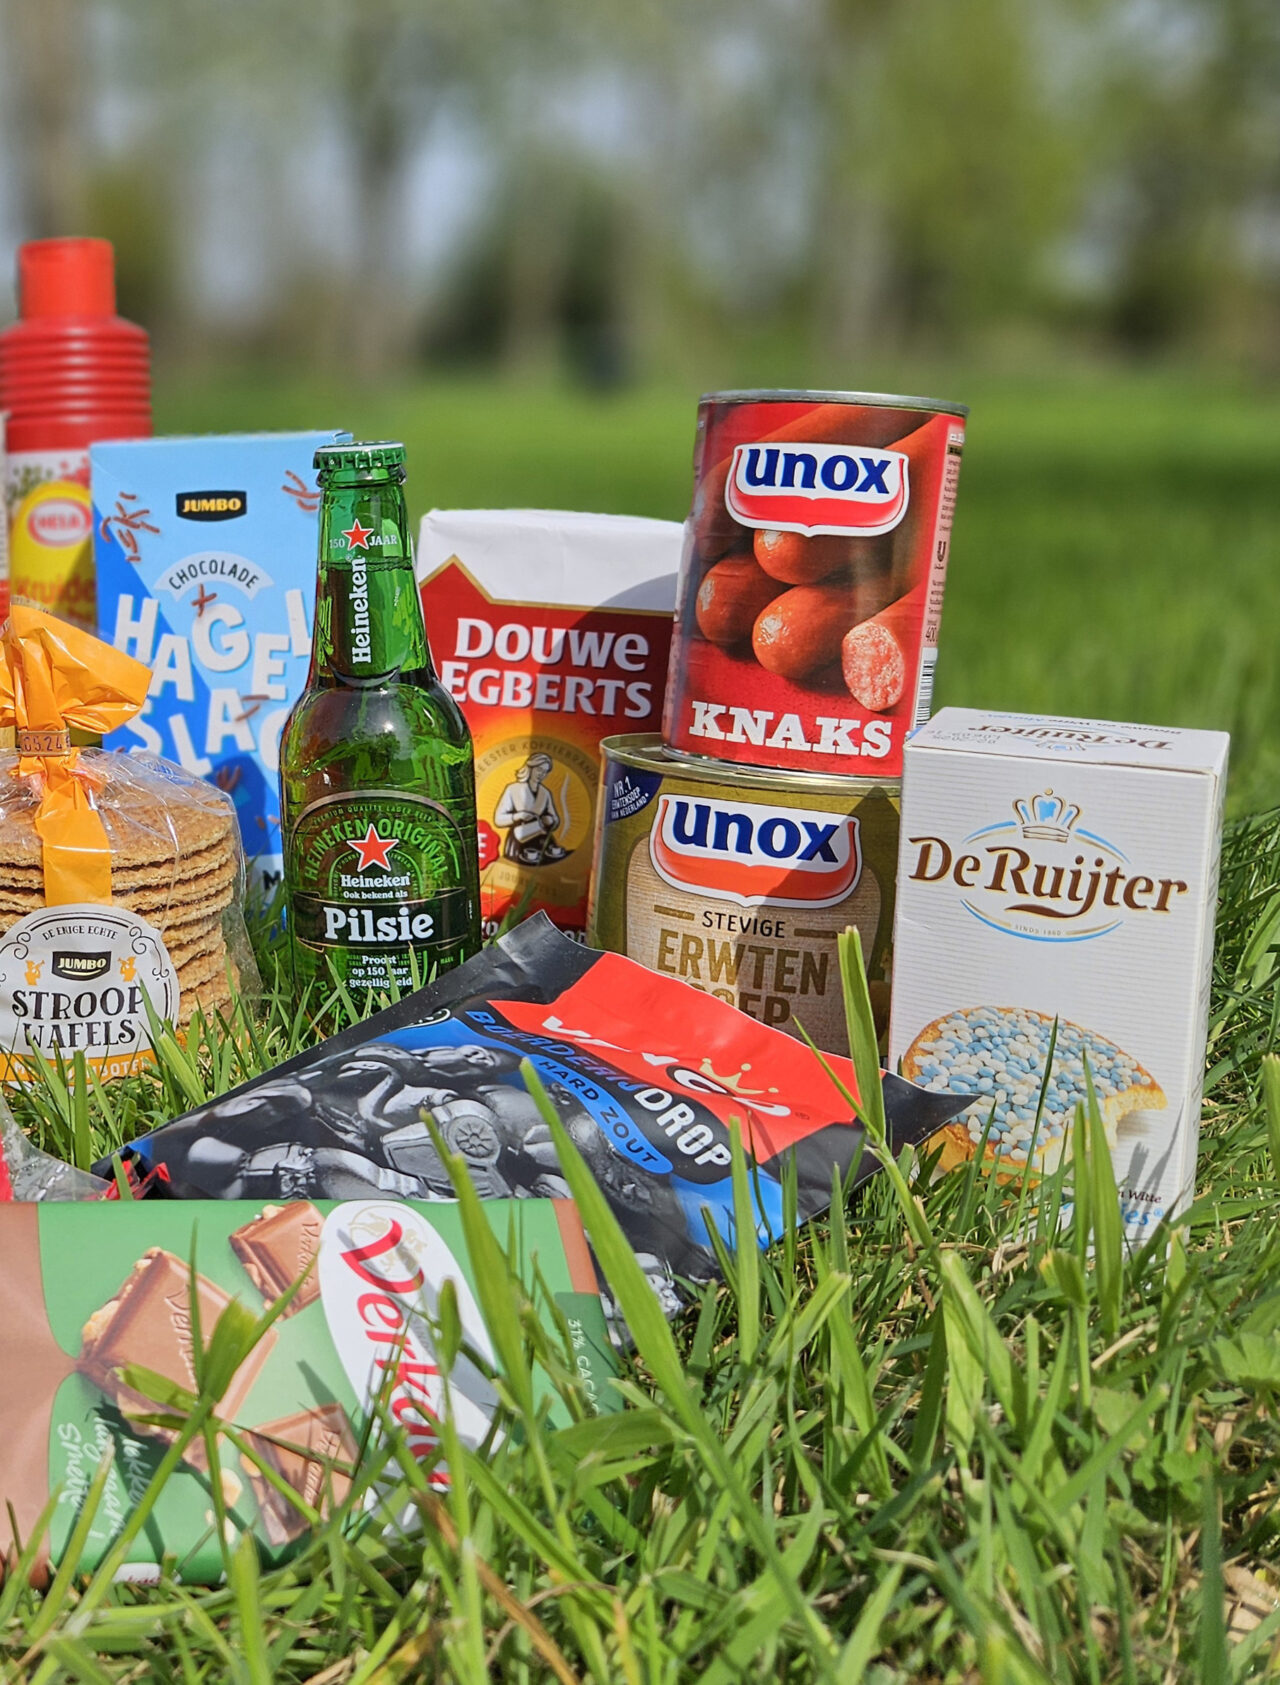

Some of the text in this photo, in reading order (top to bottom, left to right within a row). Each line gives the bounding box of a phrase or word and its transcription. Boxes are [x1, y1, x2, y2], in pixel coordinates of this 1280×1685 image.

[182, 497, 241, 513] JUMBO
[329, 534, 398, 549] 150 JAAR
[168, 558, 260, 590] CHOCOLADE
[349, 556, 371, 664] Heineken
[112, 587, 312, 702] HAGEL
[439, 660, 652, 719] EGBERTS
[688, 700, 893, 759] KNAKS
[305, 818, 369, 881] HEINEKEN
[377, 818, 448, 879] ORIGINAL
[340, 873, 411, 889] Heineken
[343, 889, 409, 899] Ook bekend als
[907, 836, 1190, 920] De Ruijter
[42, 925, 119, 941] DE ENIGE ECHTE
[323, 906, 435, 943] Pilsie
[702, 910, 786, 939] STEVIGE
[57, 957, 107, 971] JUMBO
[352, 966, 409, 977] op 150 aar
[656, 927, 830, 997] ERWTEN
[349, 977, 413, 989] gezelligeid
[11, 986, 145, 1021] STROOP
[23, 1018, 136, 1049] WAFELS
[538, 1058, 601, 1101] HARD
[599, 1105, 659, 1164] ZOUT
[1128, 1188, 1163, 1204] Witte
[568, 1317, 584, 1350] 31%
